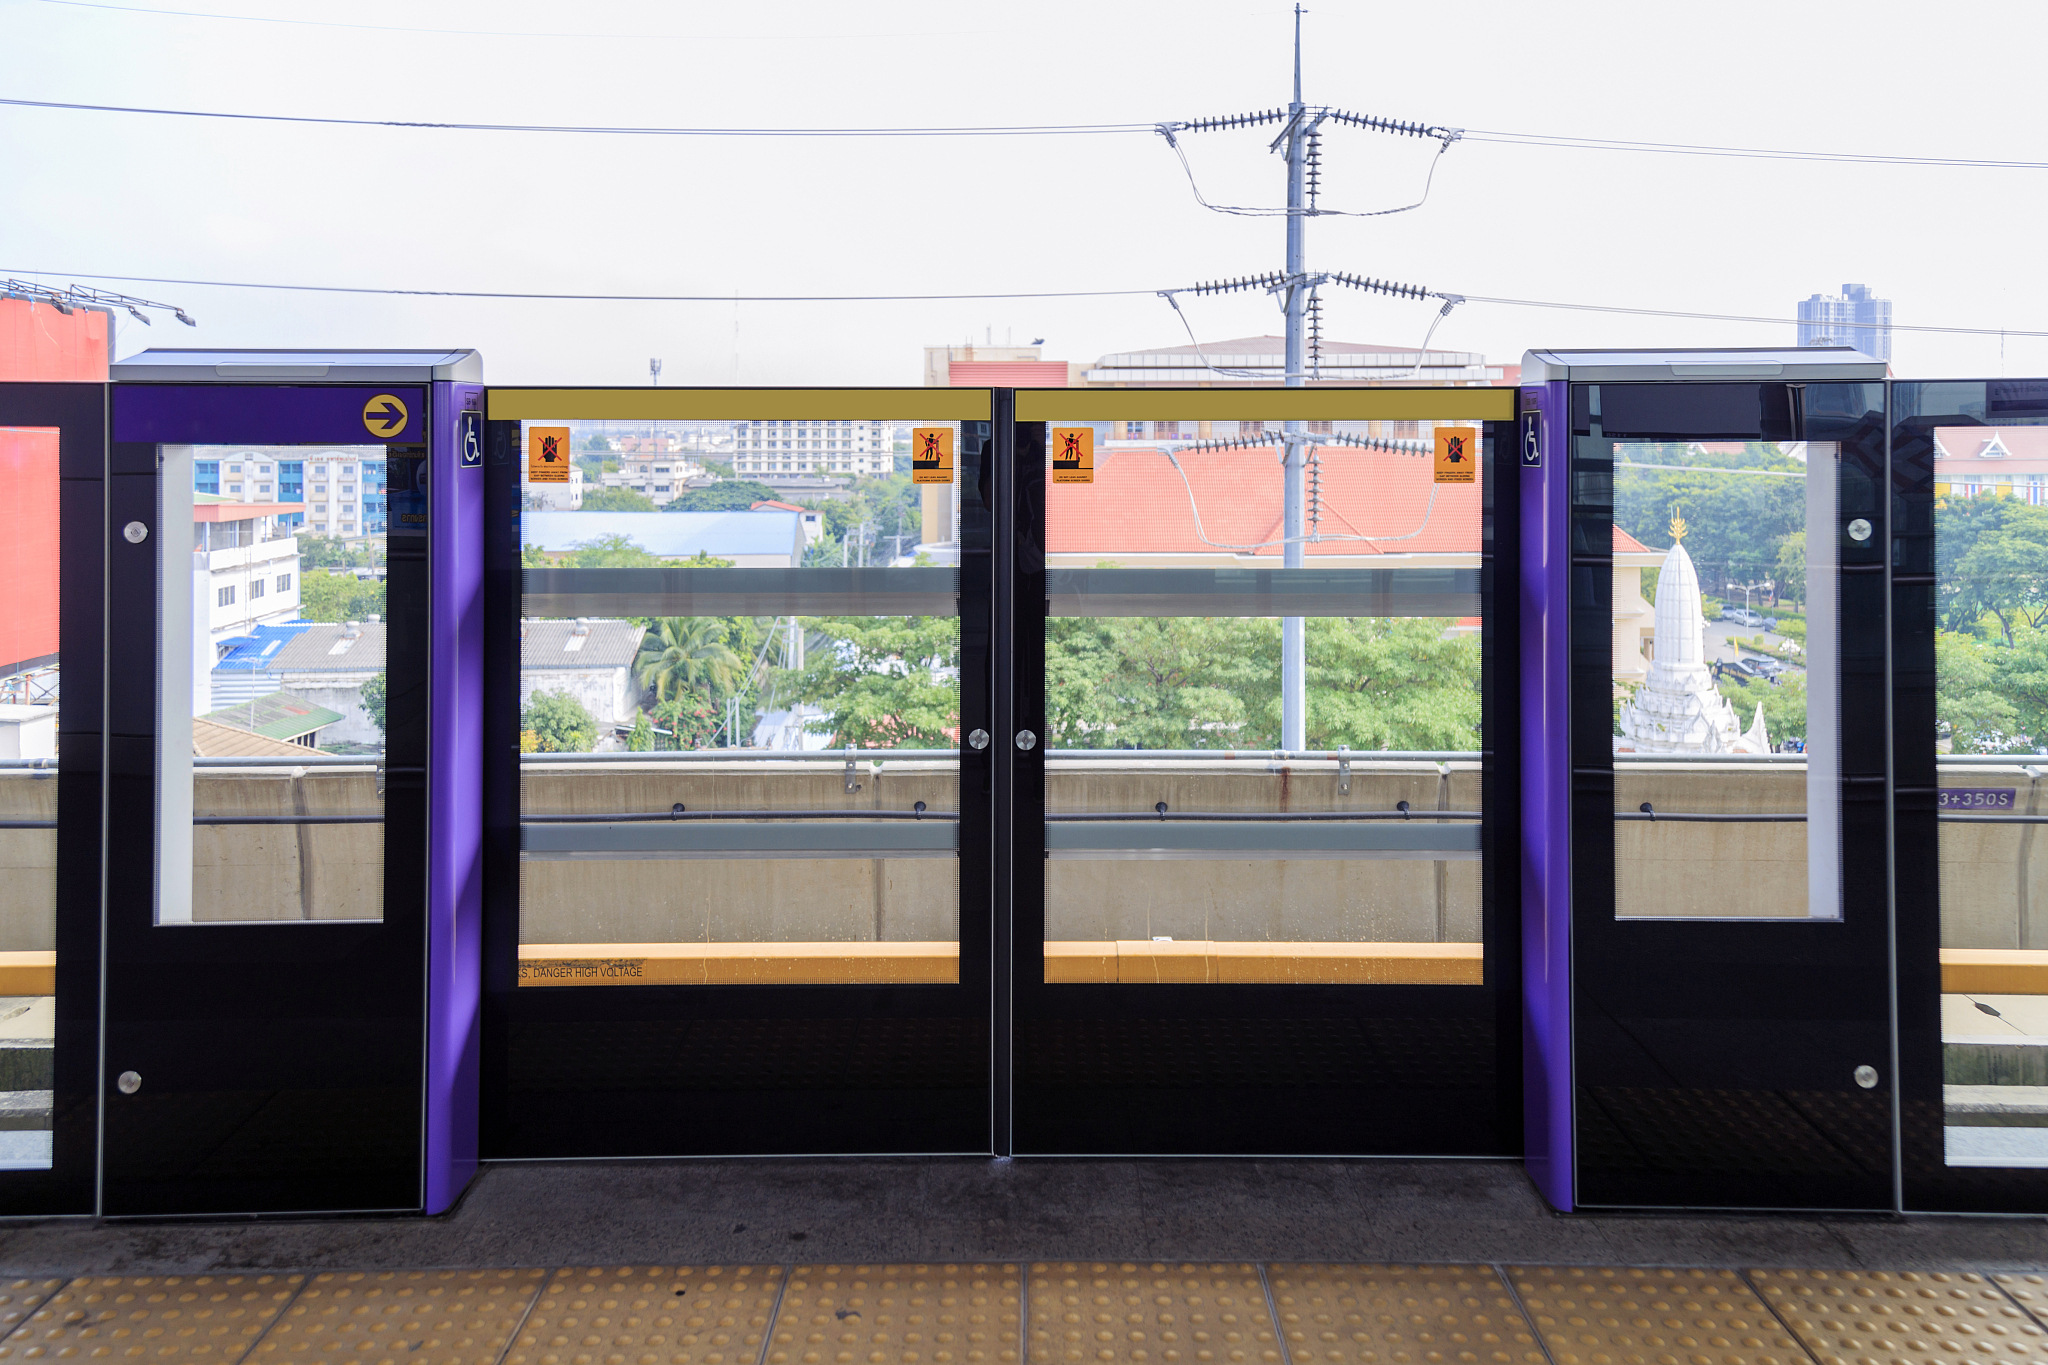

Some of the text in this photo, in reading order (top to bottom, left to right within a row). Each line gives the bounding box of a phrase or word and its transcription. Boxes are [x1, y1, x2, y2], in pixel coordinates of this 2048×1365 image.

[1939, 792, 2009, 806] 3+350S
[533, 967, 573, 978] DANGER
[575, 967, 598, 978] HIGH
[600, 966, 643, 977] VOLTAGE
